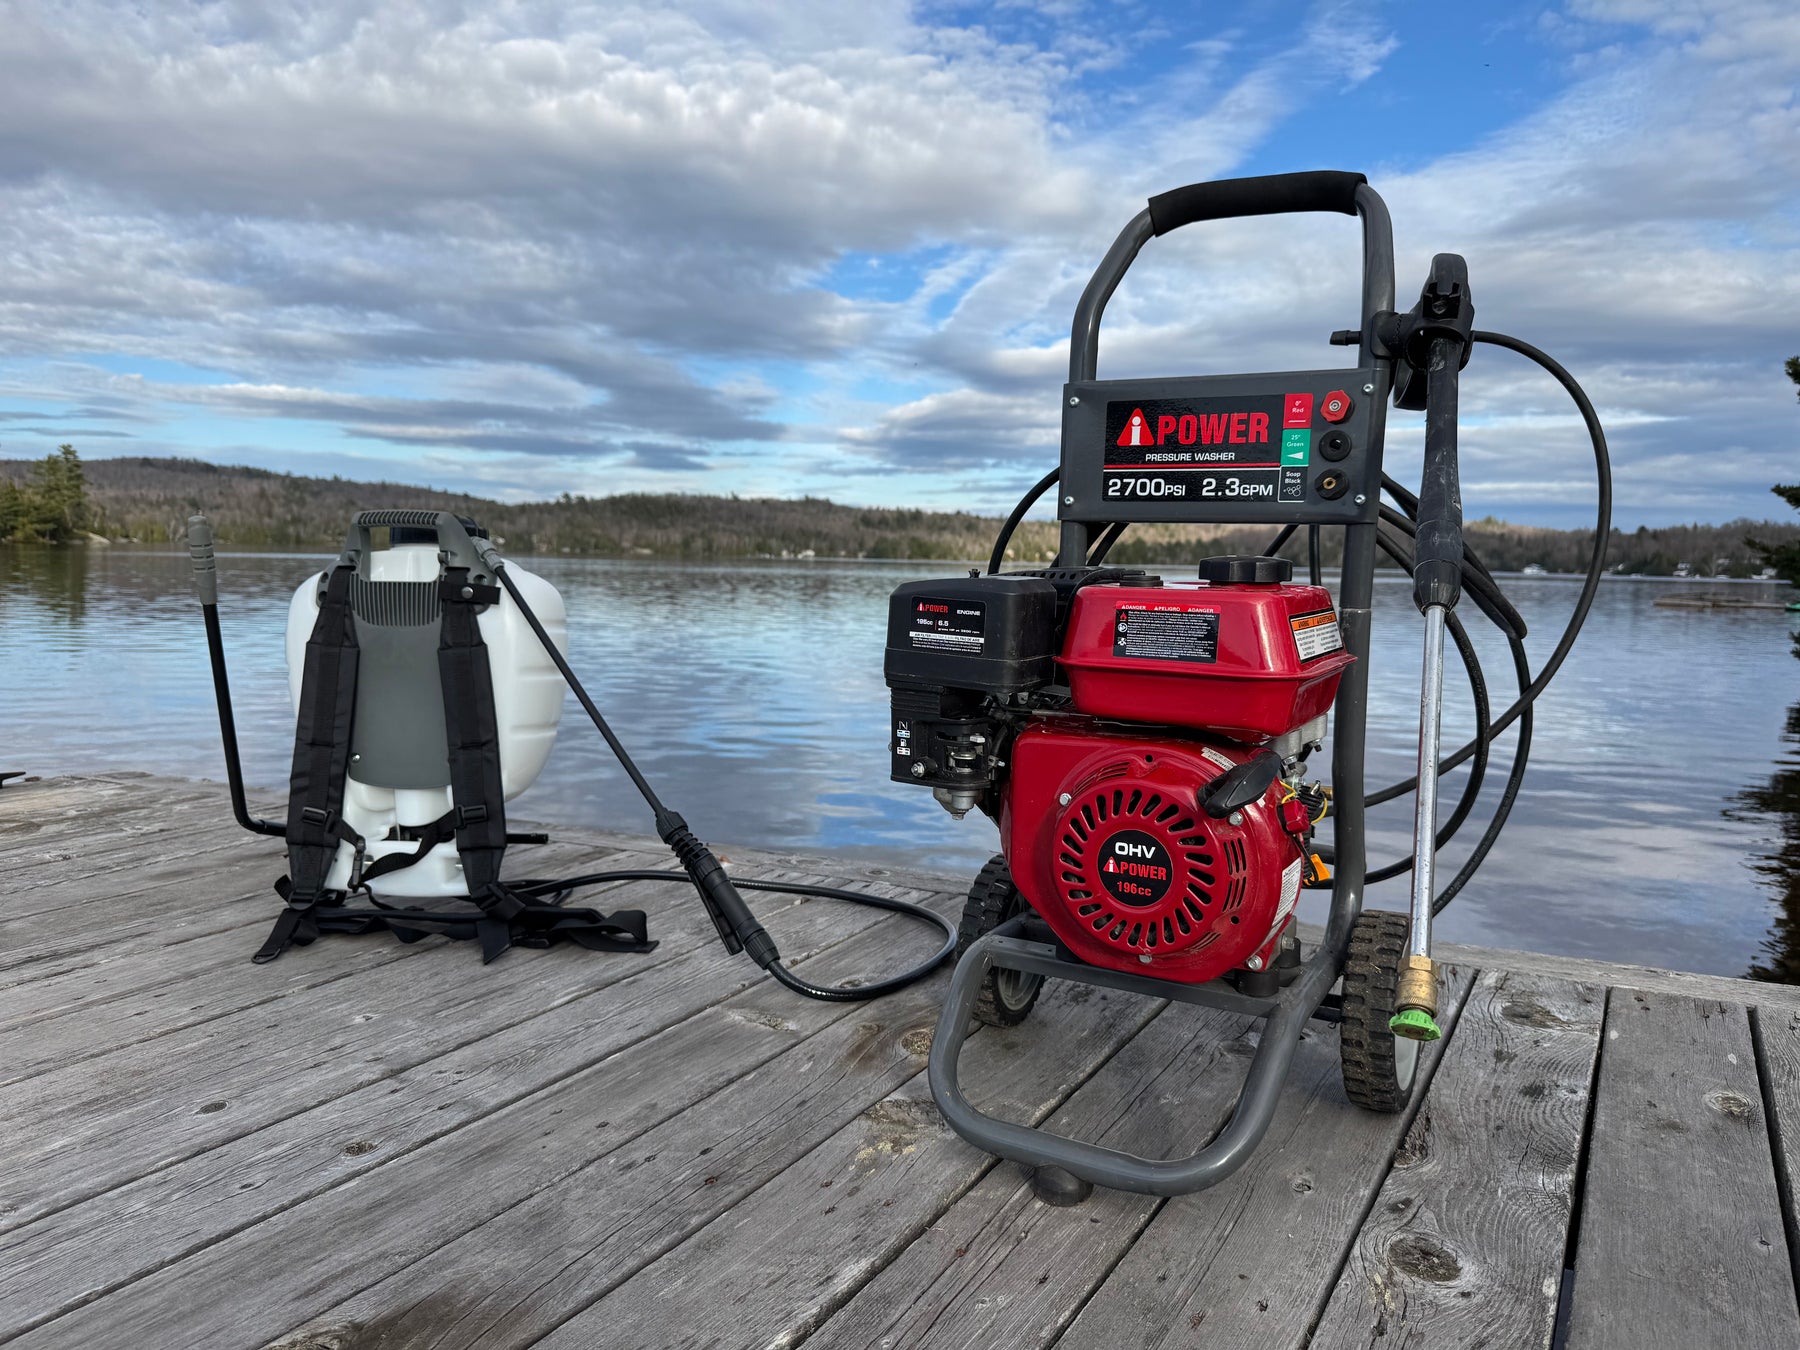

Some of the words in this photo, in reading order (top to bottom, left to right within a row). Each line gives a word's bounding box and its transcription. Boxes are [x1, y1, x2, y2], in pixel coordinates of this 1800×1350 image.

[1145, 453, 1192, 462] PRESSURE
[1194, 452, 1235, 461] WASHER
[1114, 841, 1156, 859] OHV
[1117, 881, 1152, 897] 196cc
